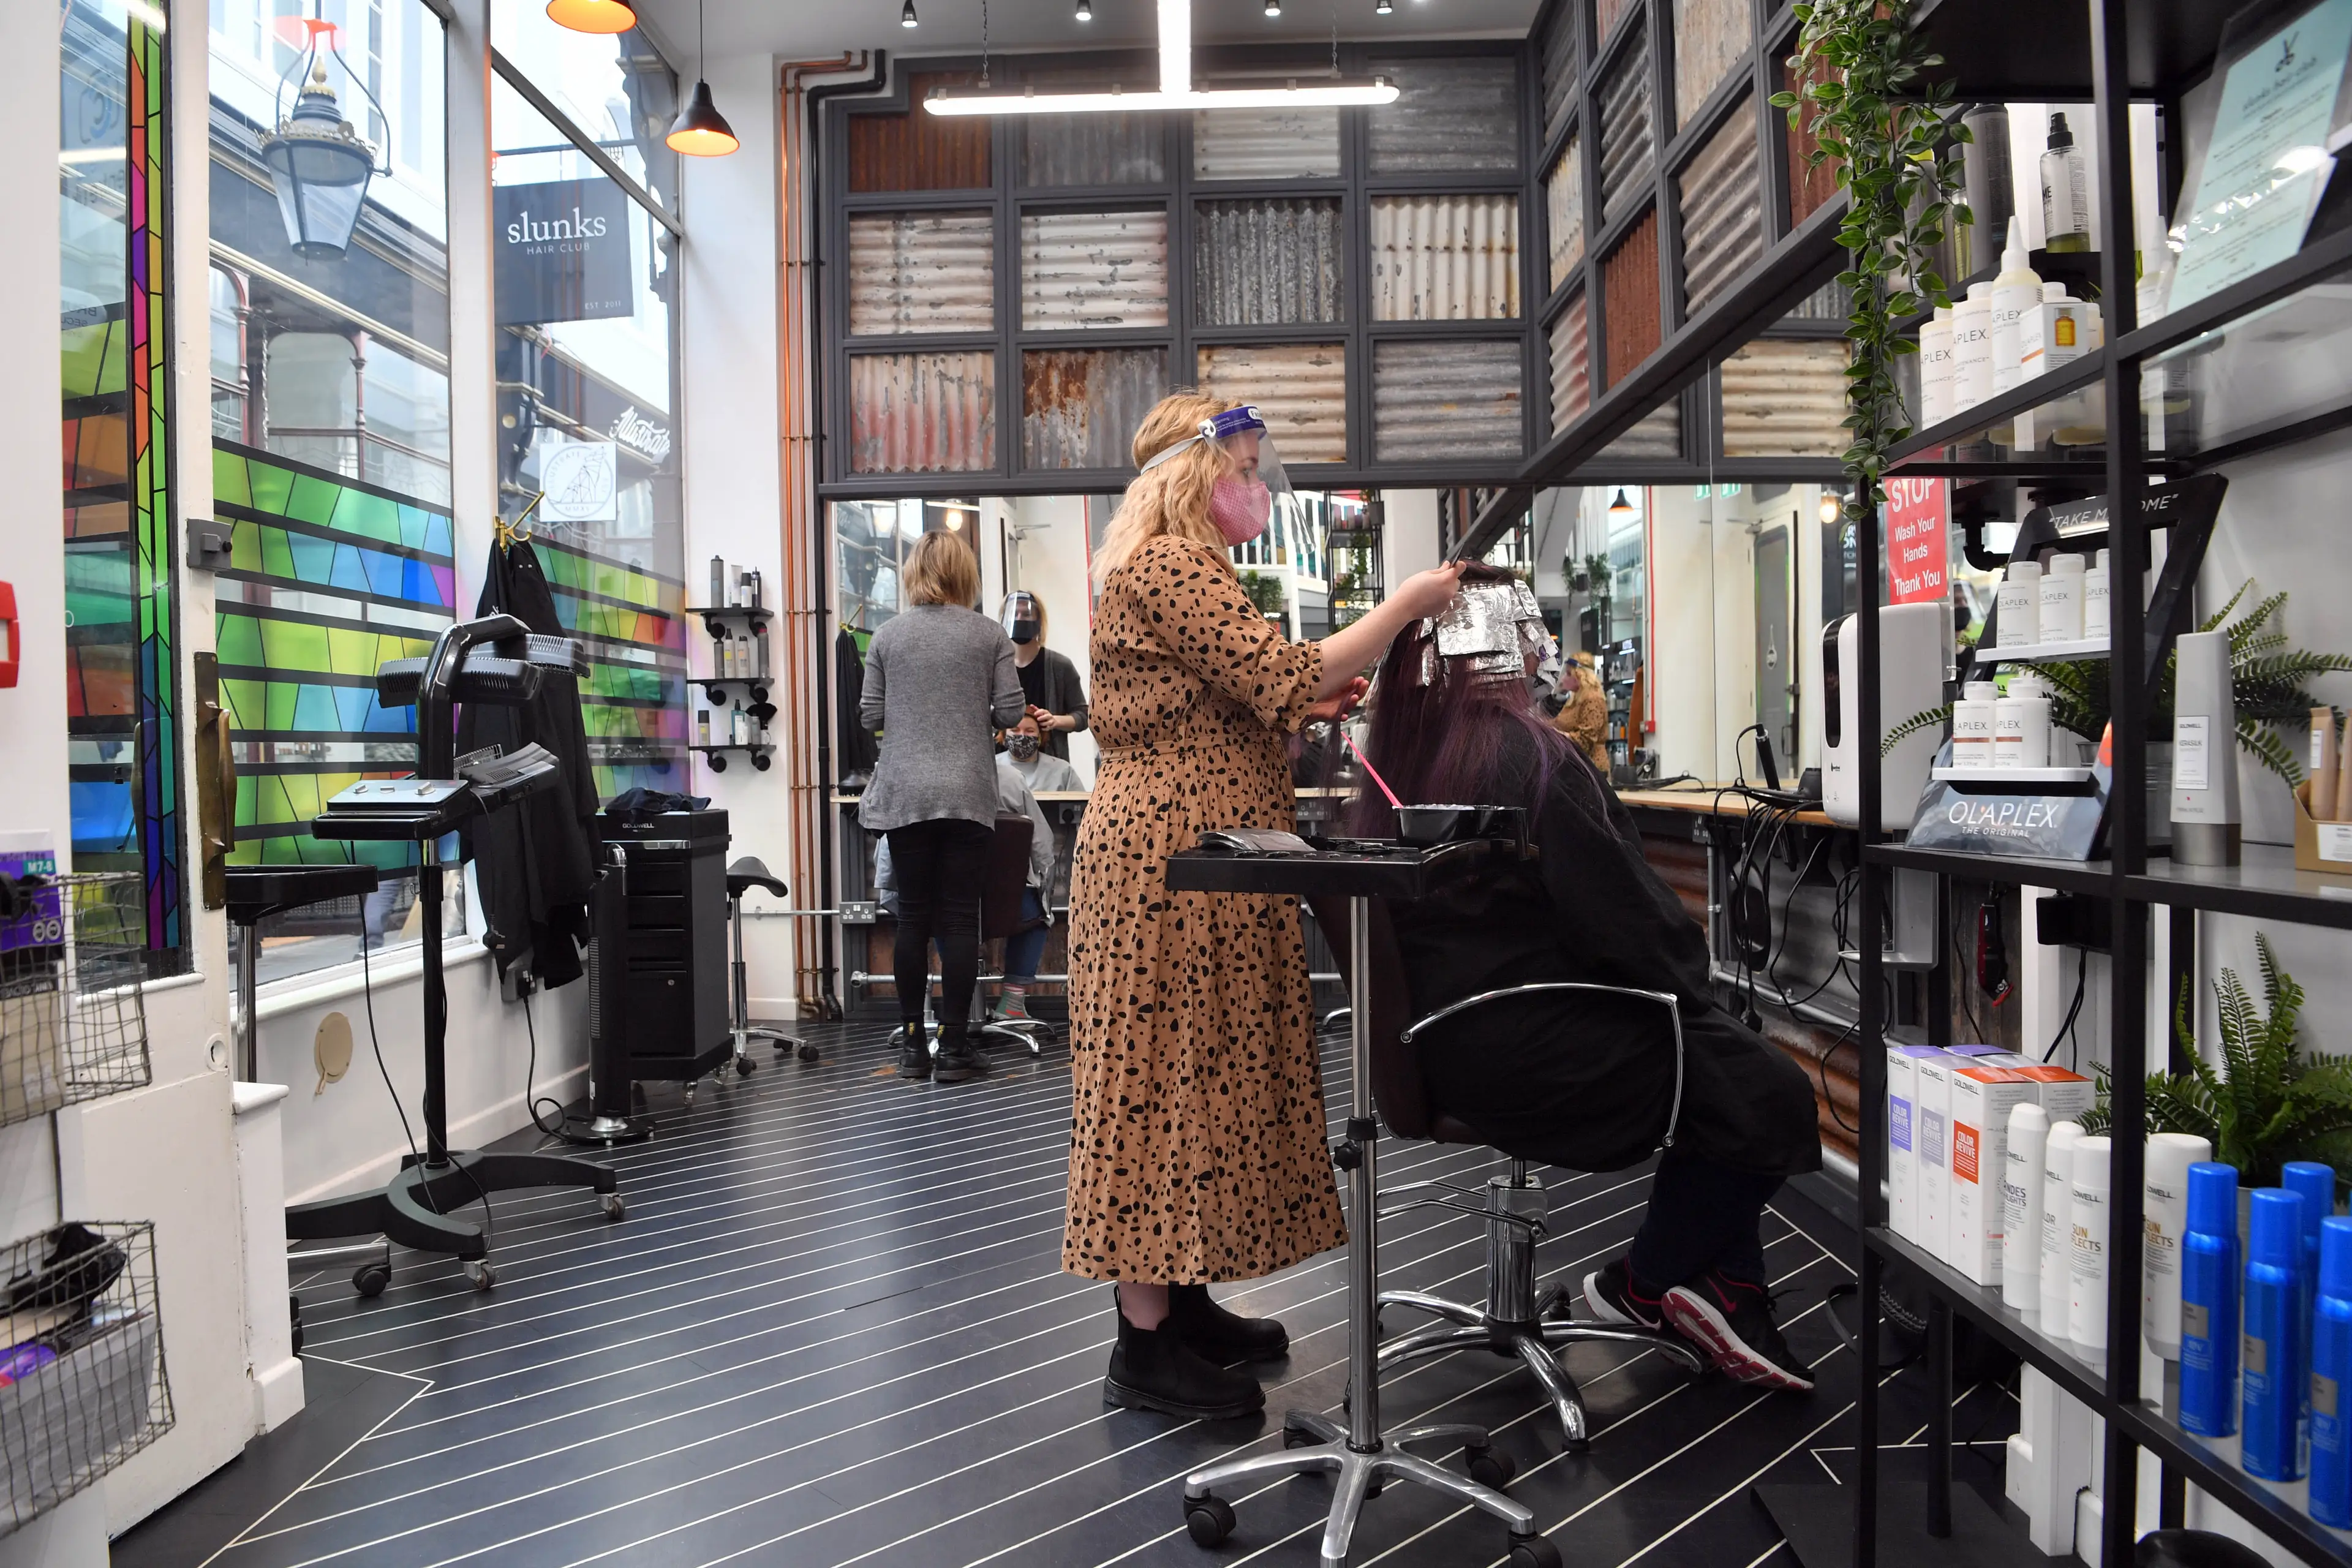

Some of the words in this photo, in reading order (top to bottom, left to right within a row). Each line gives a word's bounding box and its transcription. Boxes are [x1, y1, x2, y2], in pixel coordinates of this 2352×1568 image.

[508, 206, 606, 244] slunks
[527, 245, 555, 255] HAIR
[560, 243, 590, 253] CLUB
[1891, 478, 1936, 513] STOP
[1894, 522, 1915, 542] Wash
[1917, 517, 1936, 534] Your
[1903, 543, 1928, 564] Hands
[1894, 574, 1921, 596] Thank
[1922, 569, 1940, 589] You
[1962, 826, 1980, 835] THE
[1983, 827, 2030, 837] ORIGINAL
[1889, 1055, 1911, 1070] GOLDWELL
[1920, 1066, 1945, 1082] GOLDWELL
[1954, 1079, 1980, 1095] GOLDWELL
[1893, 1103, 1907, 1118] COLOR
[1891, 1113, 1909, 1129] REVIVE
[1924, 1116, 1940, 1132] COLOR
[1923, 1126, 1942, 1143] REVIVE
[1958, 1131, 1974, 1147] COLOR
[1956, 1140, 1976, 1159] REVIVE
